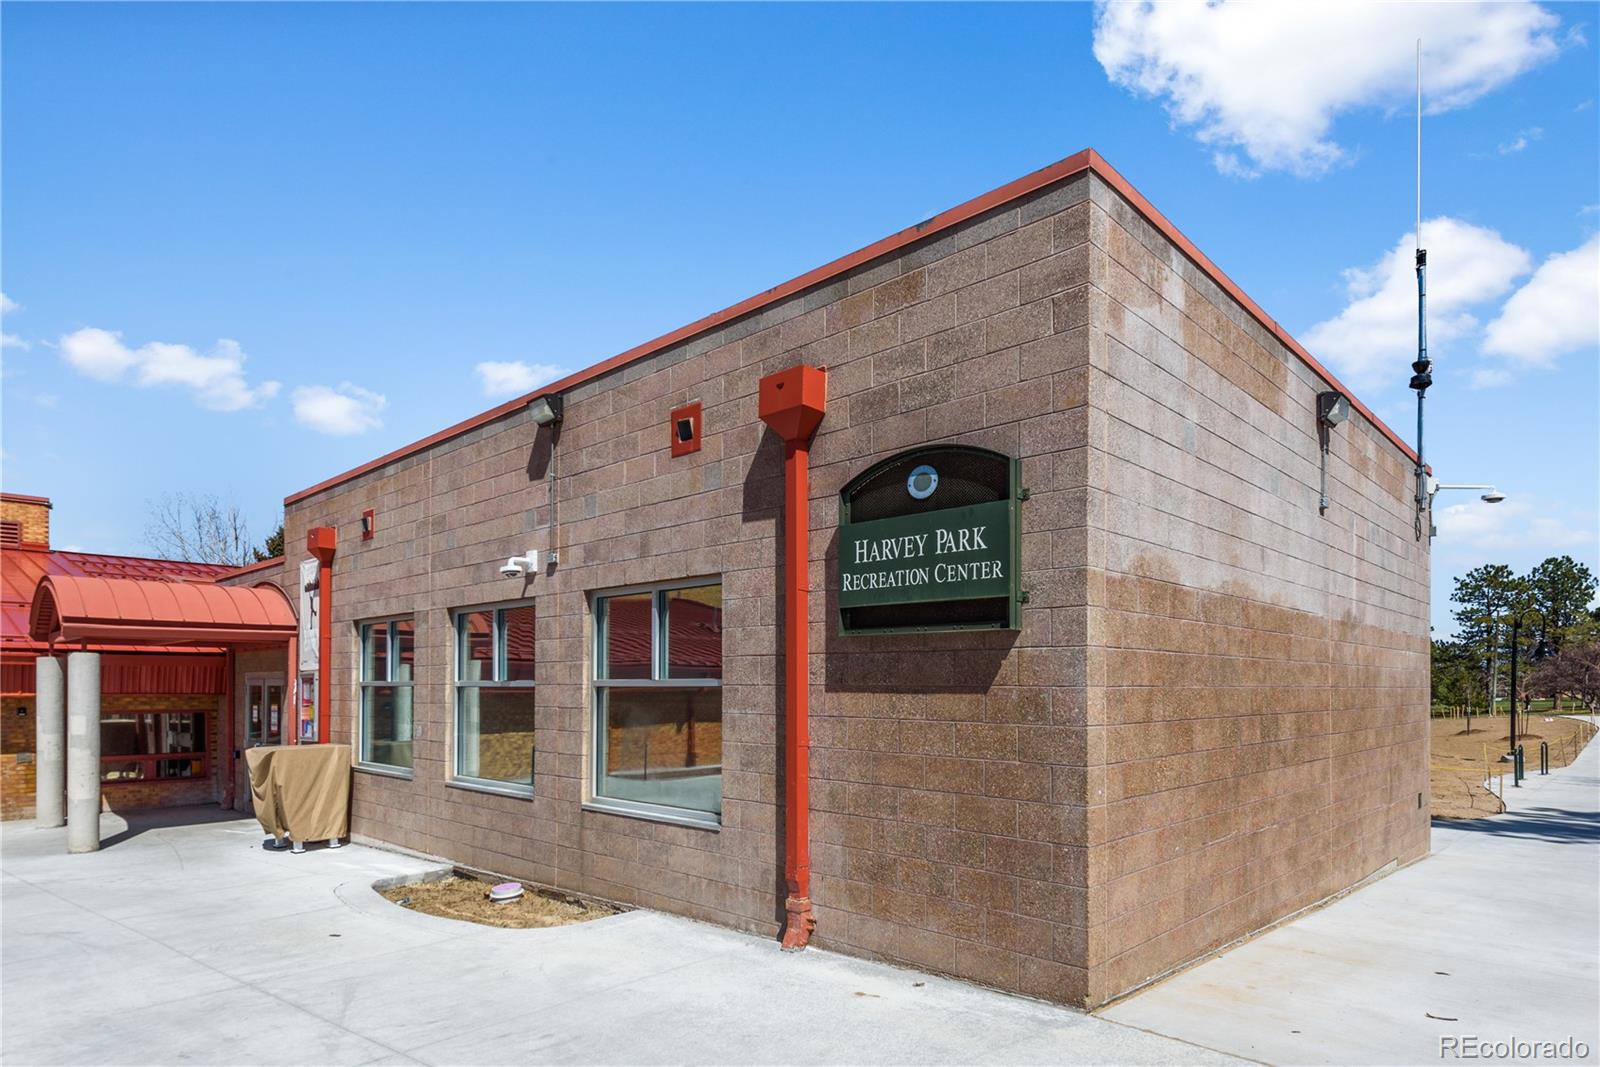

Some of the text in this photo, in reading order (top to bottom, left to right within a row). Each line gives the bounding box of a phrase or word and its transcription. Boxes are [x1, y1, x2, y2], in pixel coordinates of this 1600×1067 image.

[854, 526, 988, 564] HARVEY PARK
[842, 560, 1004, 592] RECREATION CENTER
